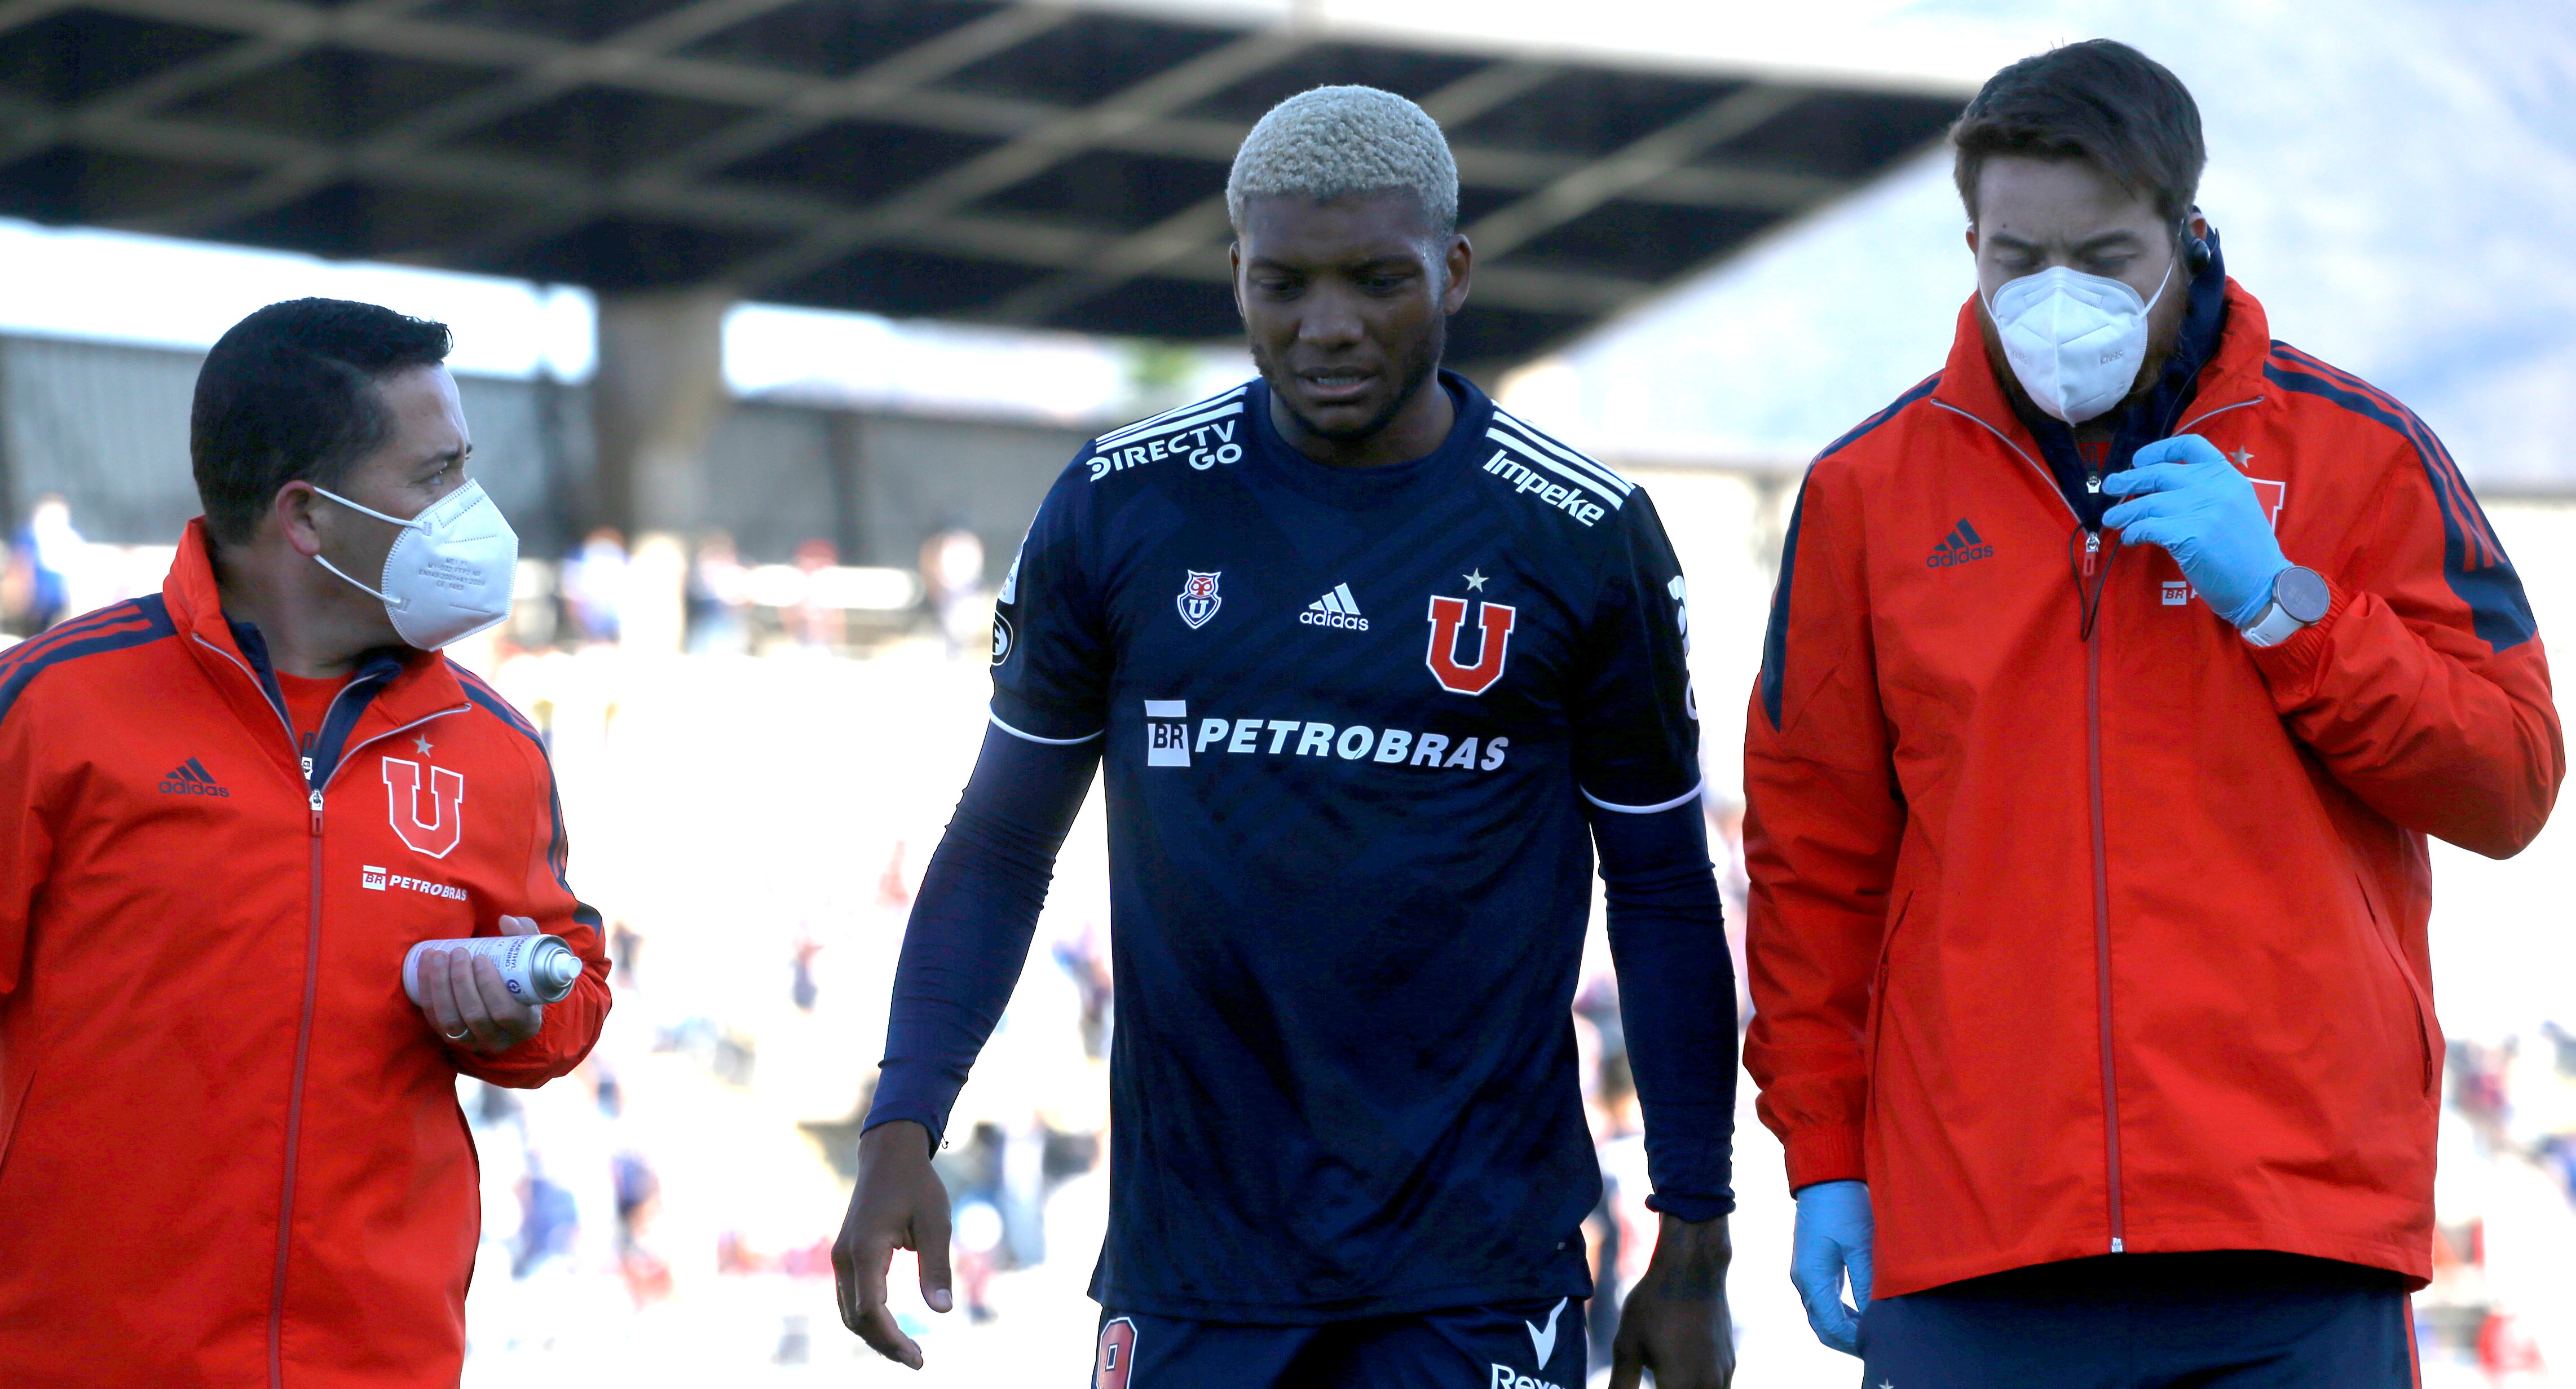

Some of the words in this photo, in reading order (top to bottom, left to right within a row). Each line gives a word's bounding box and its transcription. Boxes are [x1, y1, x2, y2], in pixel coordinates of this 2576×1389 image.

[1086, 420, 1235, 482] DIRECTV
[1189, 443, 1242, 470] GO
[1483, 449, 1605, 527] Impeke
[1926, 545, 1995, 568] adidas
[1189, 599, 1209, 619] U
[1299, 610, 1369, 631] adidas
[1425, 594, 1516, 695] U
[1194, 718, 1509, 770] PETROBRAS
[158, 779, 230, 797] adidas
[381, 755, 464, 859] U
[389, 875, 467, 901] PETROBRAS
